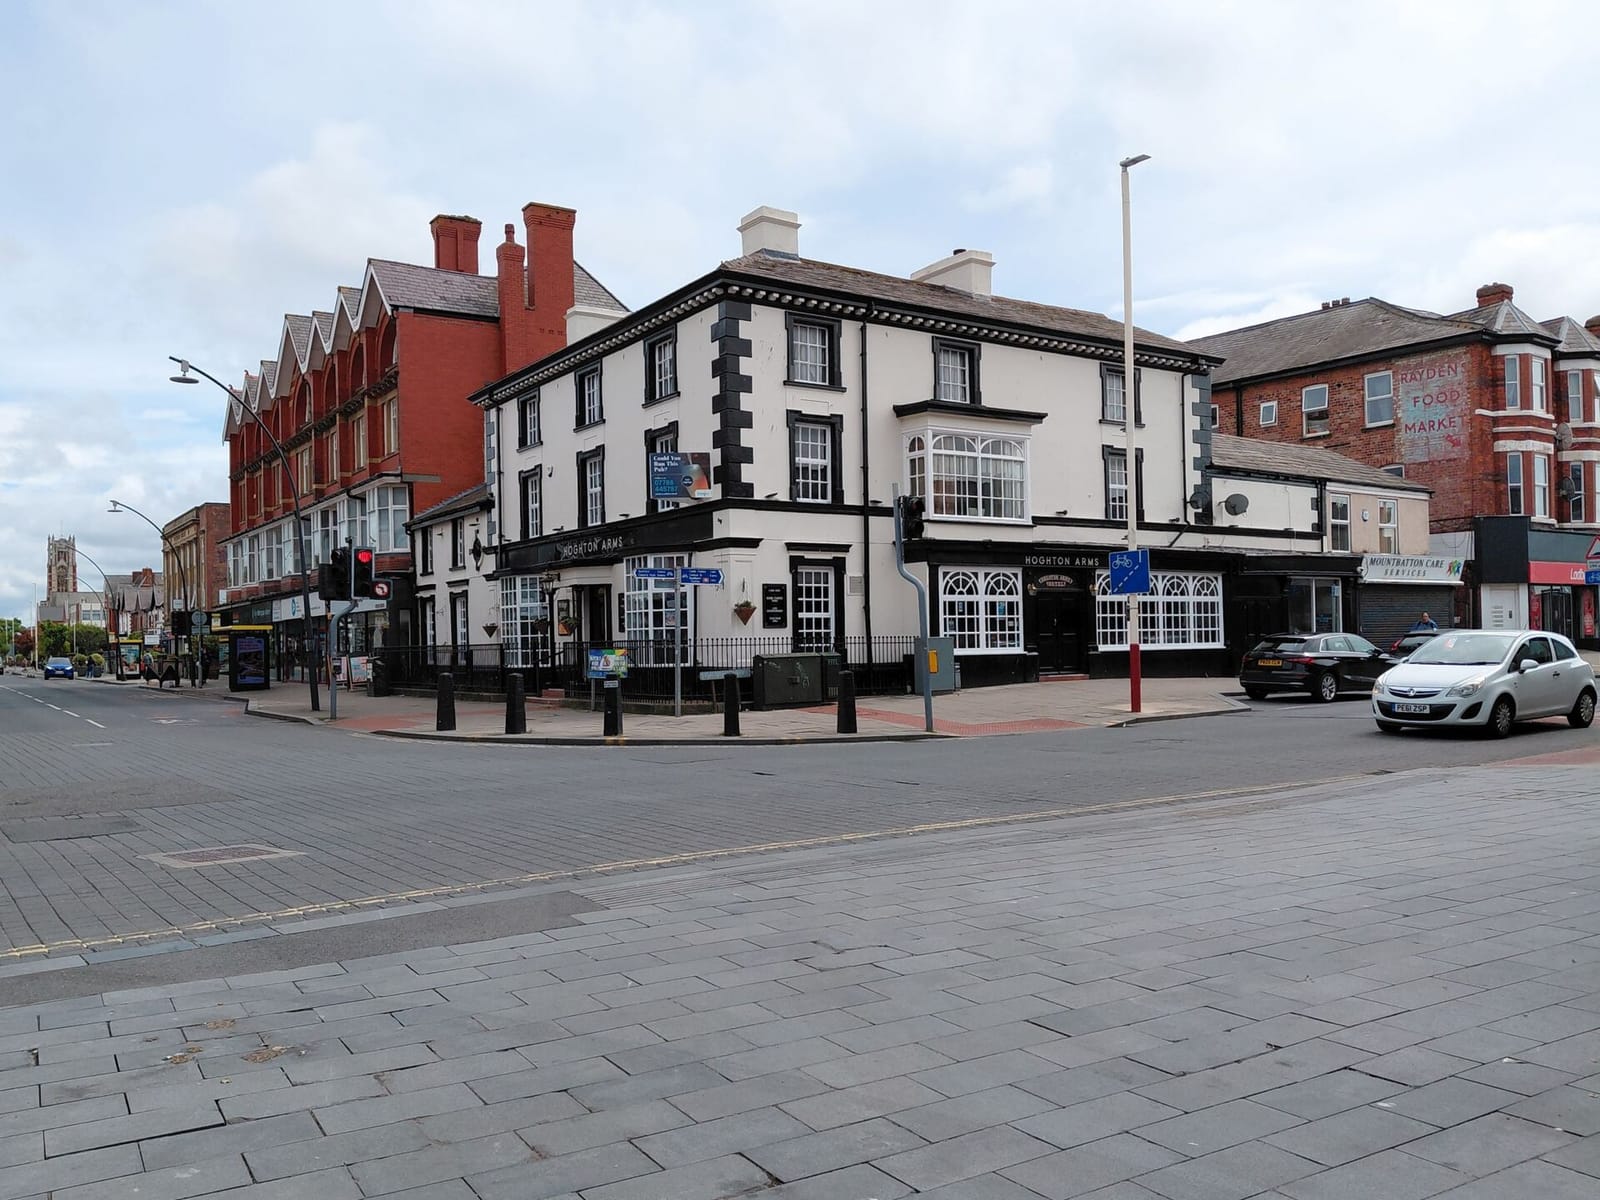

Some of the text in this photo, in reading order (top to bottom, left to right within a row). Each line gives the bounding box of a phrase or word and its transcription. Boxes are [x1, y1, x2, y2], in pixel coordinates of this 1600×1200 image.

[1413, 390, 1460, 407] FOOD
[563, 536, 623, 556] HOGHTON ARMS
[1025, 555, 1100, 566] HOGHTON ARMS
[1368, 557, 1444, 569] MOUNTBATTON CARE
[1384, 568, 1427, 577] SERVICES
[1396, 704, 1428, 713] PE61 ZSP
